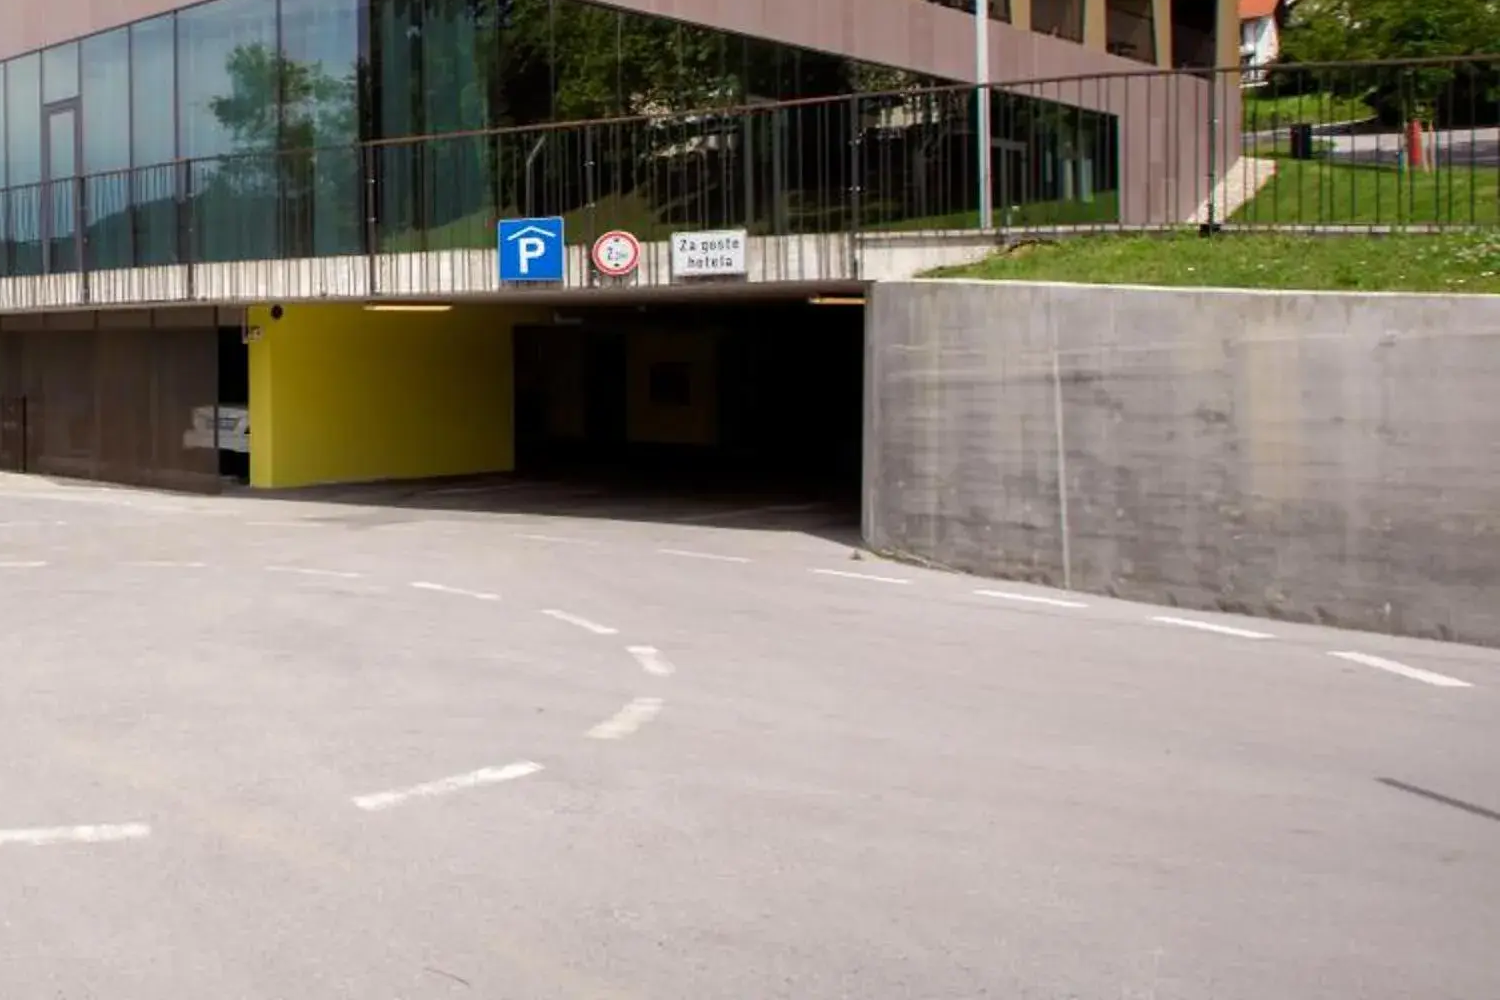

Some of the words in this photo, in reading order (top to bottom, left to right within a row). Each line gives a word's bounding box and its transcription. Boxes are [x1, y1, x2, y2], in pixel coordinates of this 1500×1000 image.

[679, 239, 696, 252] Za
[701, 238, 740, 254] goste
[518, 237, 545, 274] P
[687, 255, 733, 269] hotela
